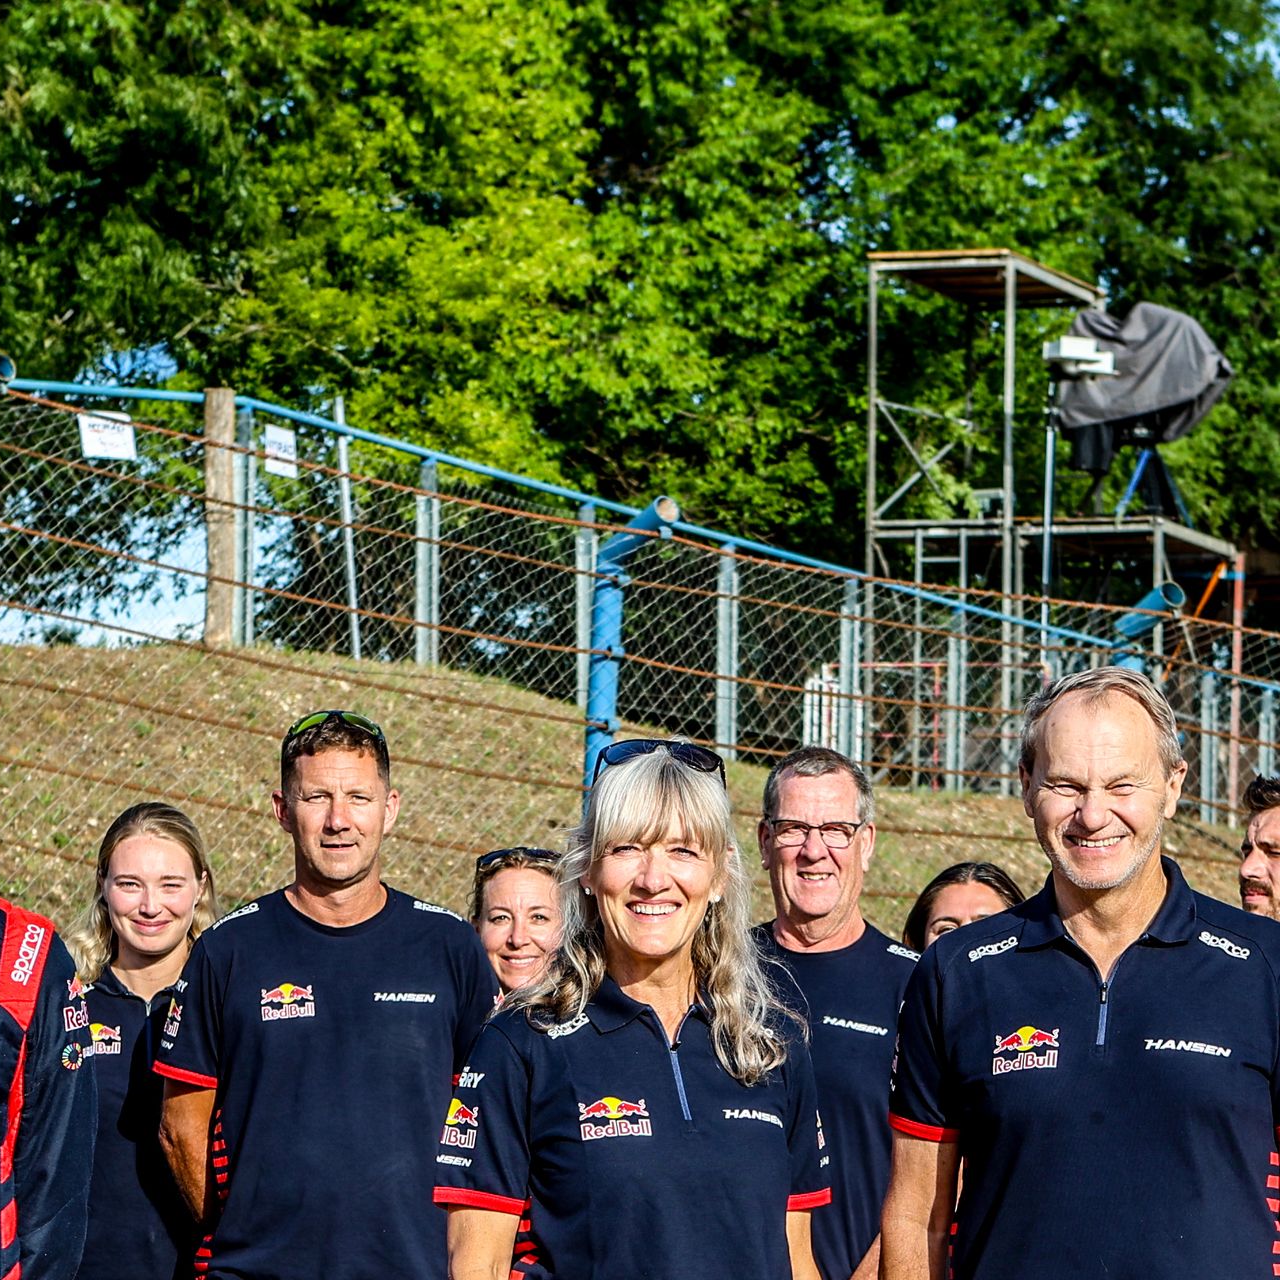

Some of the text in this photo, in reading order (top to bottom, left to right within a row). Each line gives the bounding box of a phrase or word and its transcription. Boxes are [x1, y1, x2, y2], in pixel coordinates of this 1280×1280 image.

[11, 924, 45, 985] sparco
[967, 935, 1019, 962] sparco
[1198, 931, 1251, 960] sparco
[373, 991, 436, 1004] HANSEN
[261, 1002, 316, 1021] Red Bull
[822, 1015, 889, 1037] HANSEN
[1143, 1038, 1232, 1058] HANSEN
[992, 1049, 1058, 1076] Red Bull
[580, 1119, 653, 1141] Red Bull
